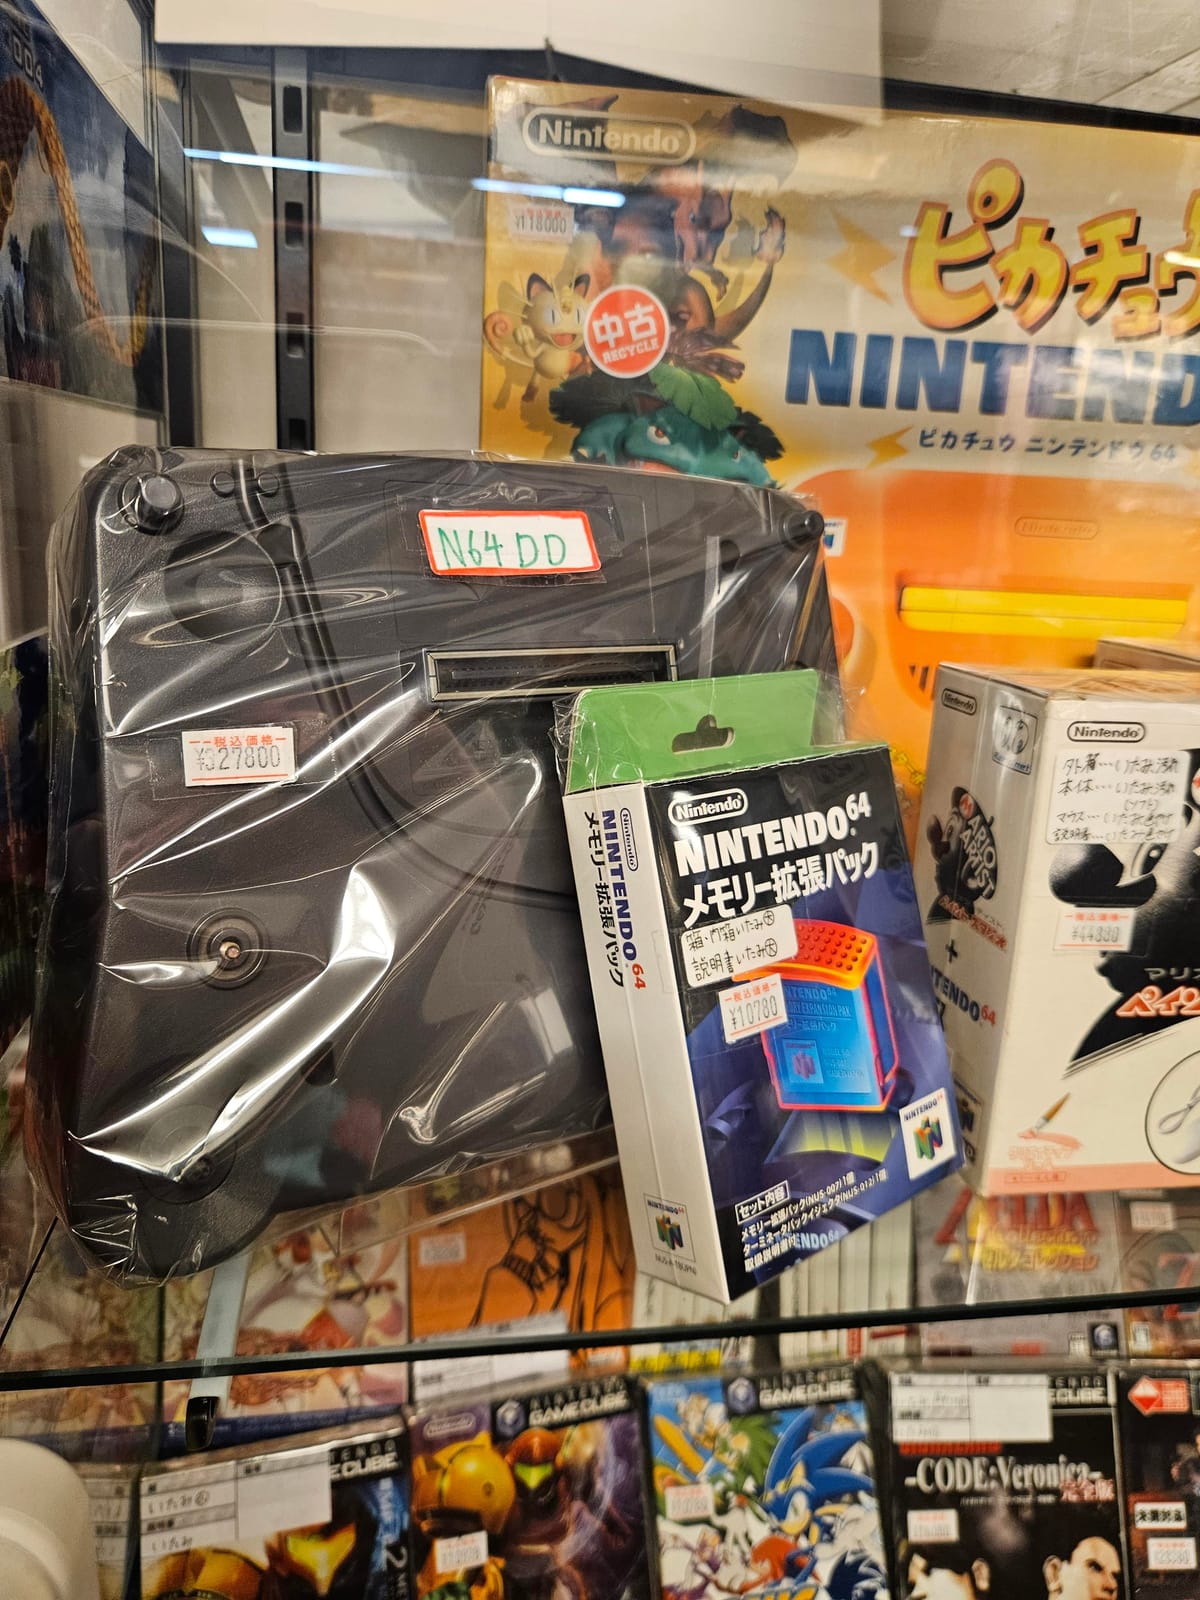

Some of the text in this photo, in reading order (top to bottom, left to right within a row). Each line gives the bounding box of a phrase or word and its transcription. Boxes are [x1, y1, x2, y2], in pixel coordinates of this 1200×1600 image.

[538, 119, 680, 153] Nintendo
[592, 302, 657, 349] 中古
[602, 338, 659, 364] RECYCLE
[919, 429, 1178, 461] ピカチュウ ニンテンドウ 64
[438, 526, 504, 568] N64
[213, 735, 273, 748] 税込価格
[1074, 726, 1140, 738] Nintendo
[194, 746, 281, 771] ¥327800
[676, 796, 742, 820] Nintendo
[623, 813, 637, 867] Nintendo
[584, 811, 624, 987] メモリー拡張パック
[683, 842, 878, 929] メモリー拡張パック
[729, 995, 778, 1030] ¥10780
[739, 1186, 786, 1218] セット内容
[529, 1391, 629, 1427] GAMECUBE
[760, 1380, 855, 1409] GAMECUBE
